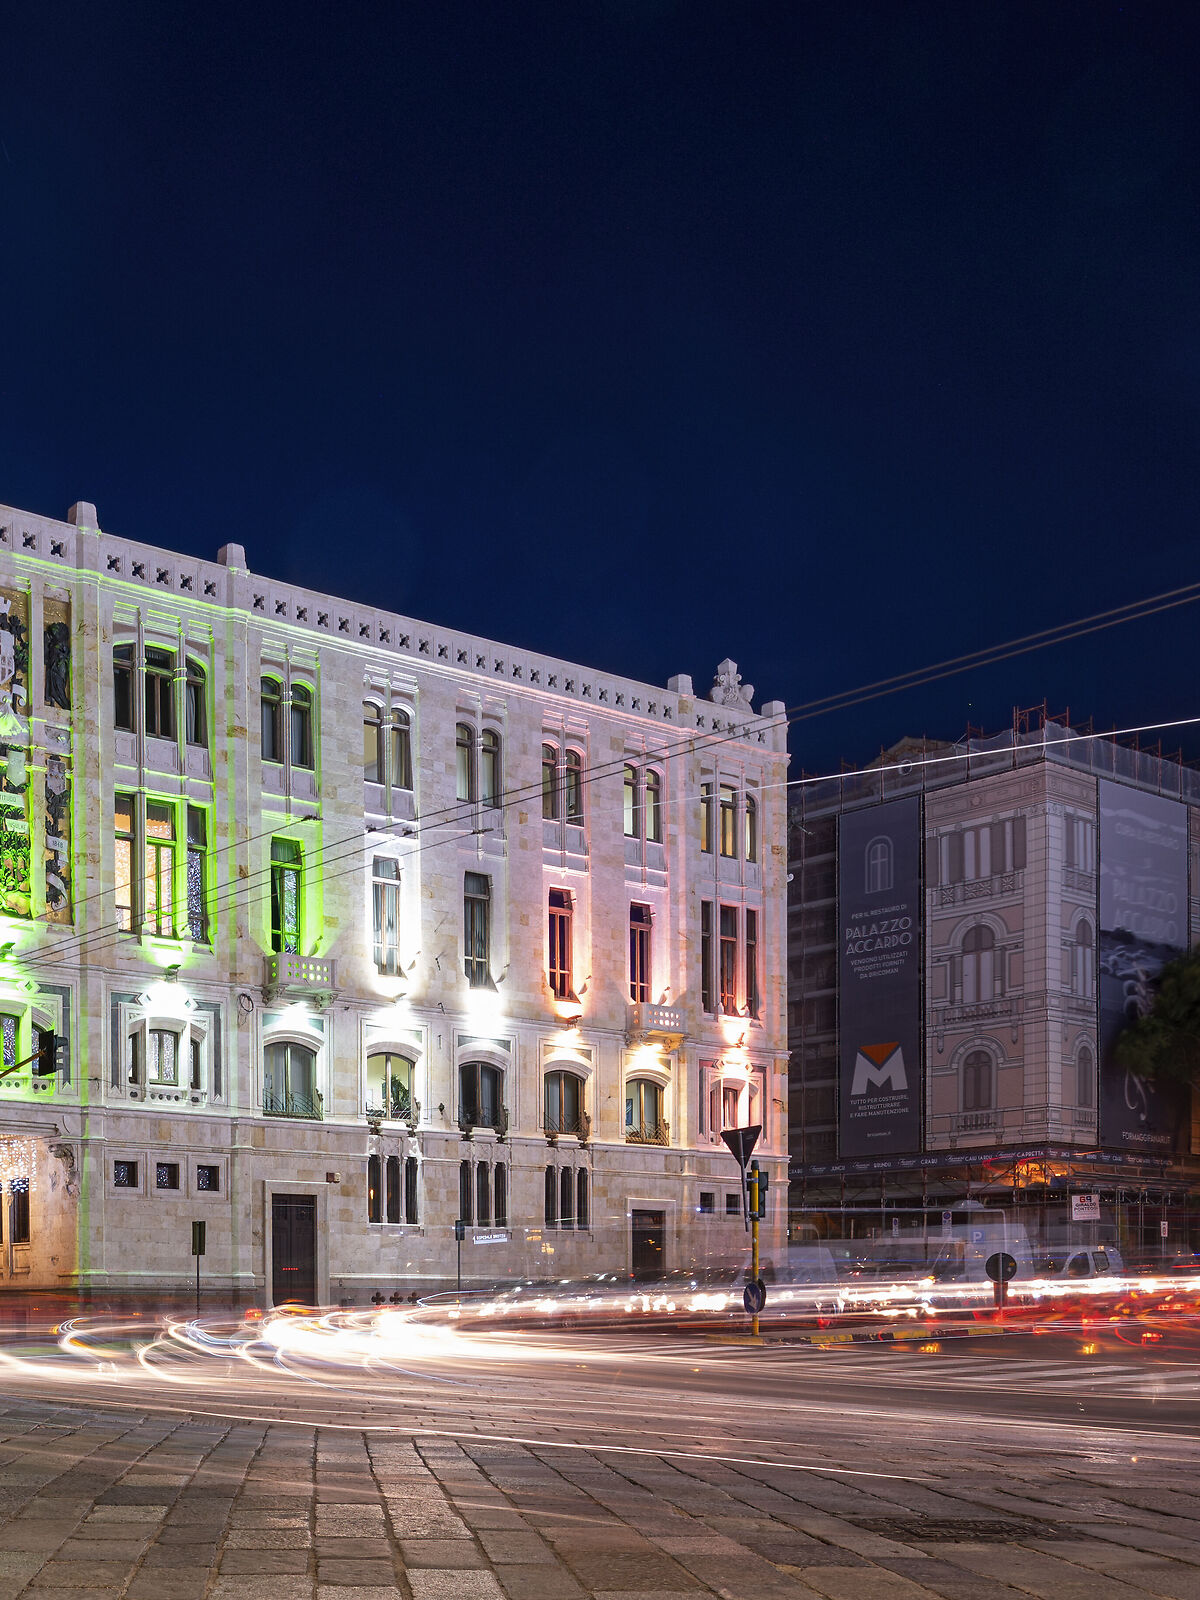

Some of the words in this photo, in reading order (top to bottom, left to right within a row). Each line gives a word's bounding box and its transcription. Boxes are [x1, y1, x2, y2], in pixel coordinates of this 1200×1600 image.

[851, 911, 864, 920] PER
[845, 916, 912, 941] PALAZZO
[845, 932, 912, 955] ACCARDO
[850, 955, 878, 966] VENGONO
[853, 962, 882, 973] PRODOTTI
